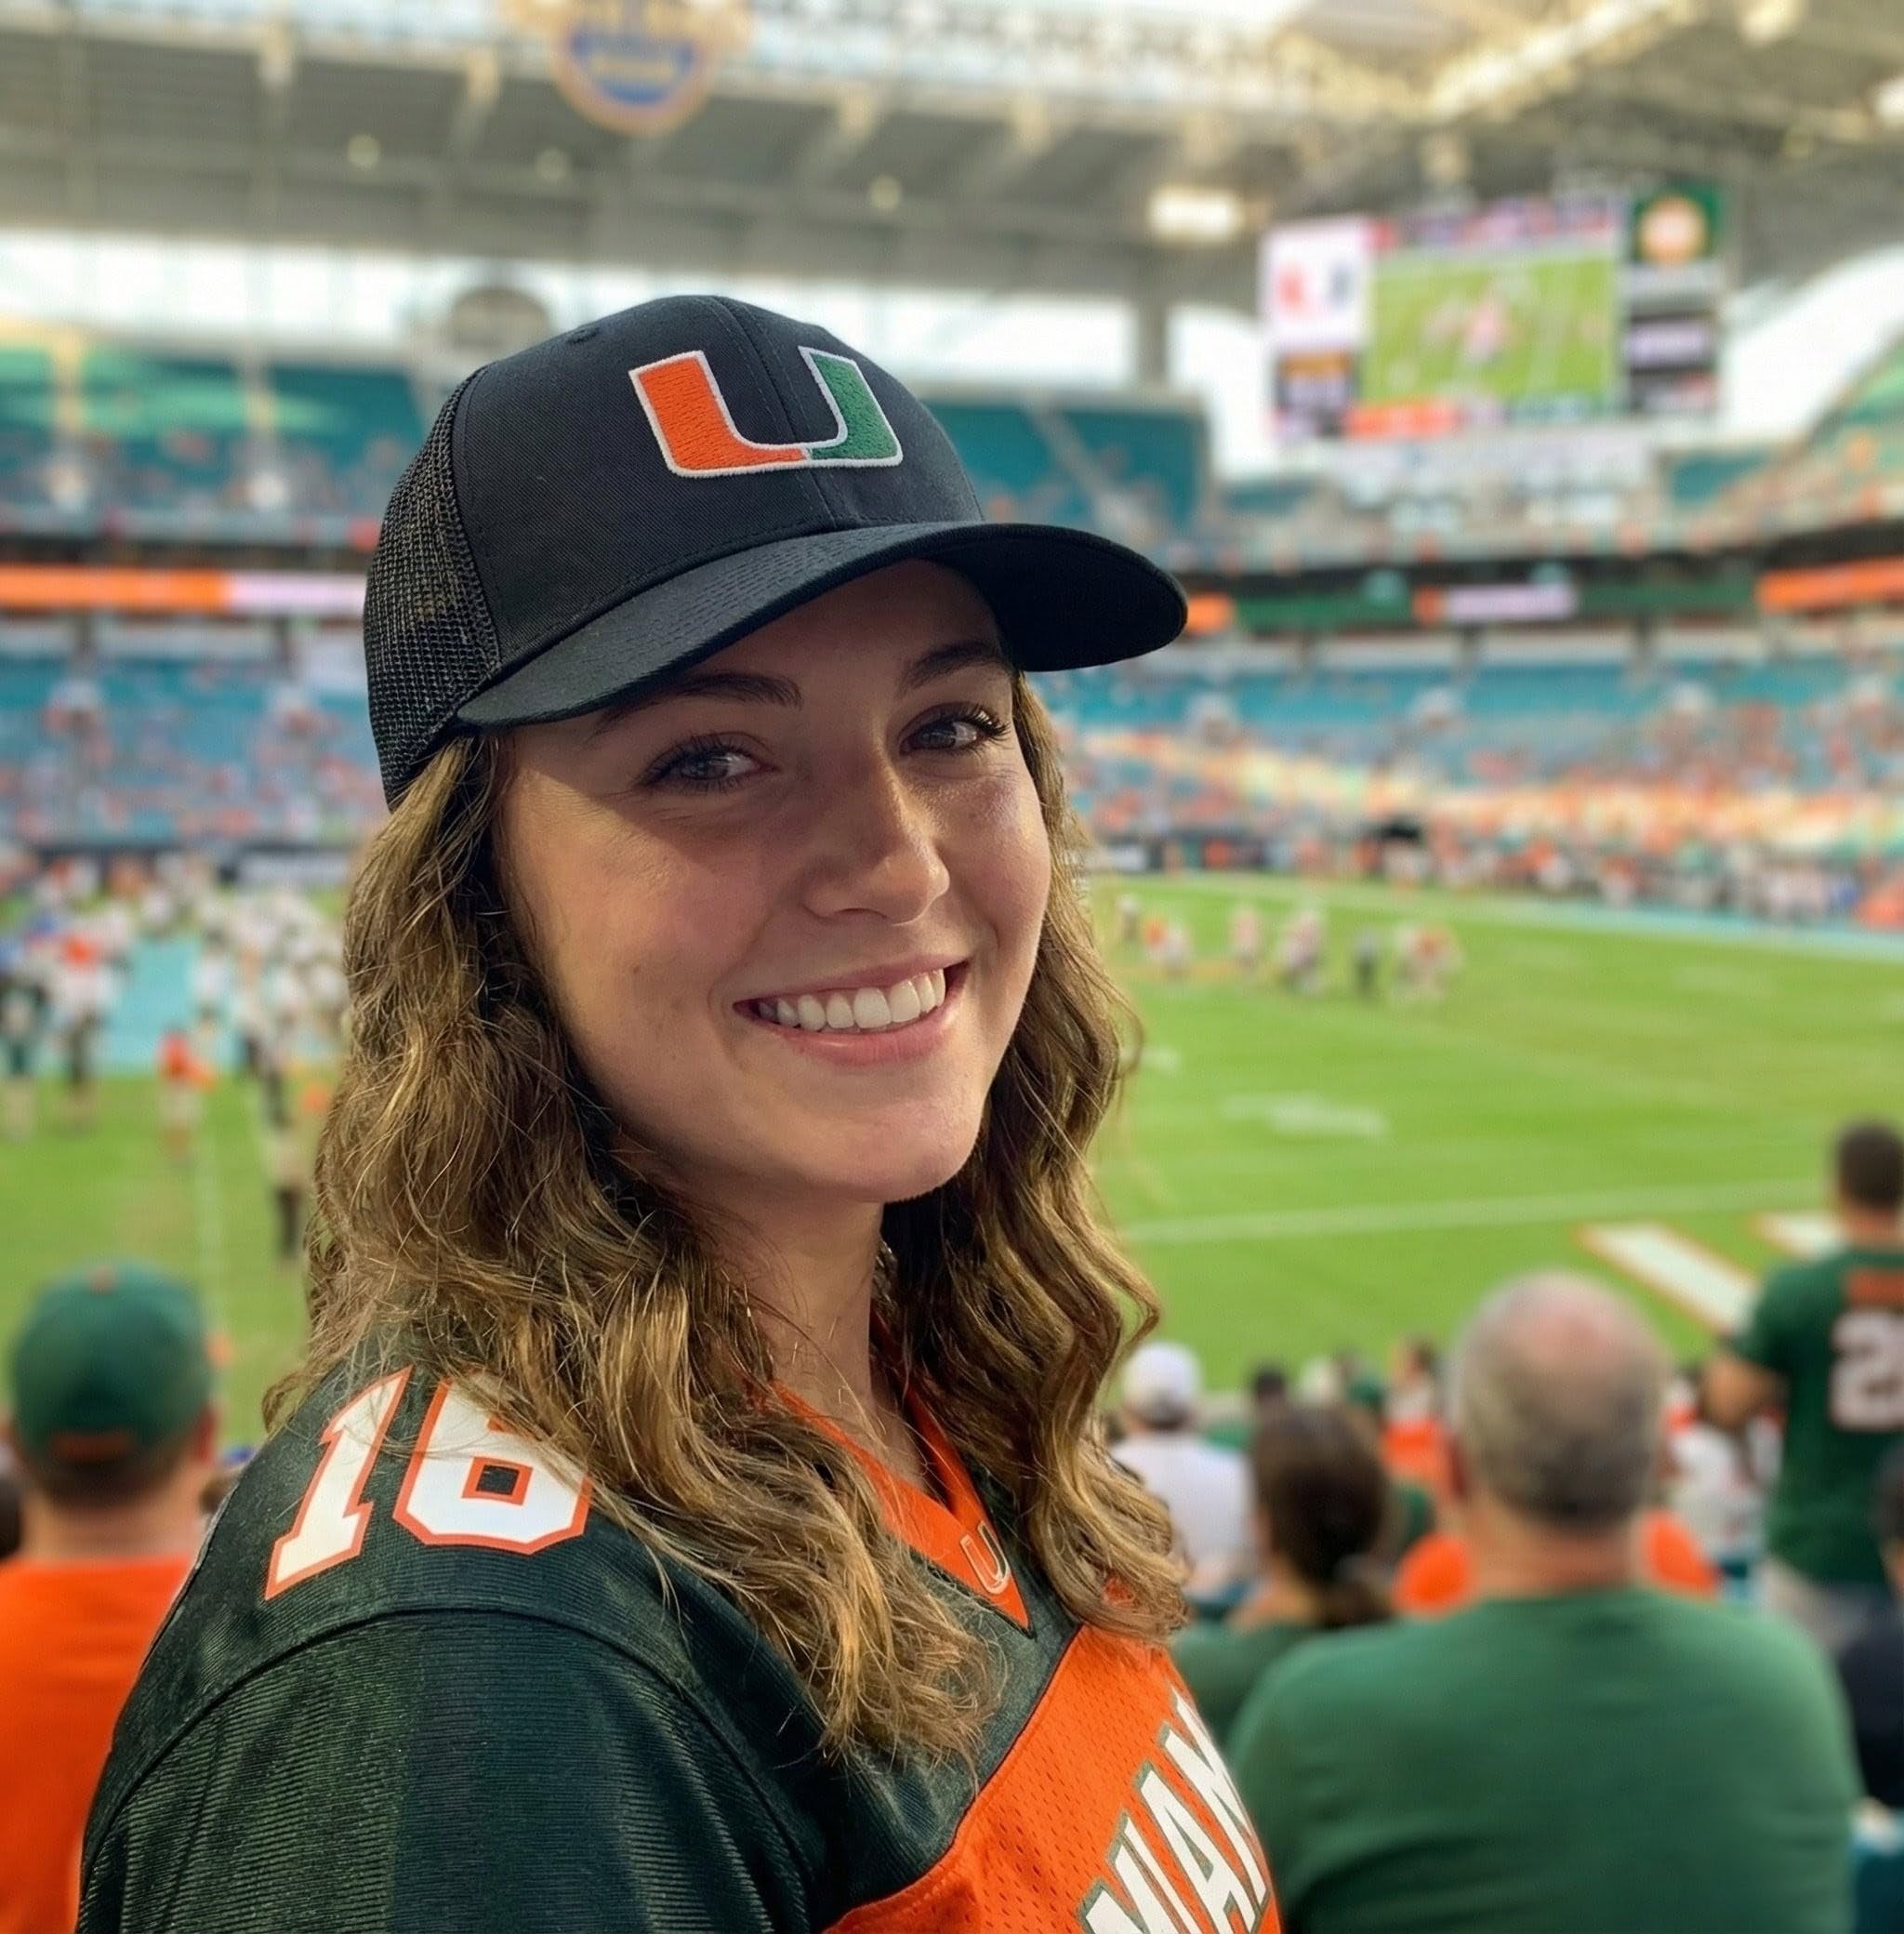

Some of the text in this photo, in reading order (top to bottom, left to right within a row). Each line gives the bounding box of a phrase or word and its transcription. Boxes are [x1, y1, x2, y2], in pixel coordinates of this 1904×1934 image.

[628, 345, 904, 478] U
[265, 1364, 597, 1601] 16
[959, 1520, 1011, 1594] U
